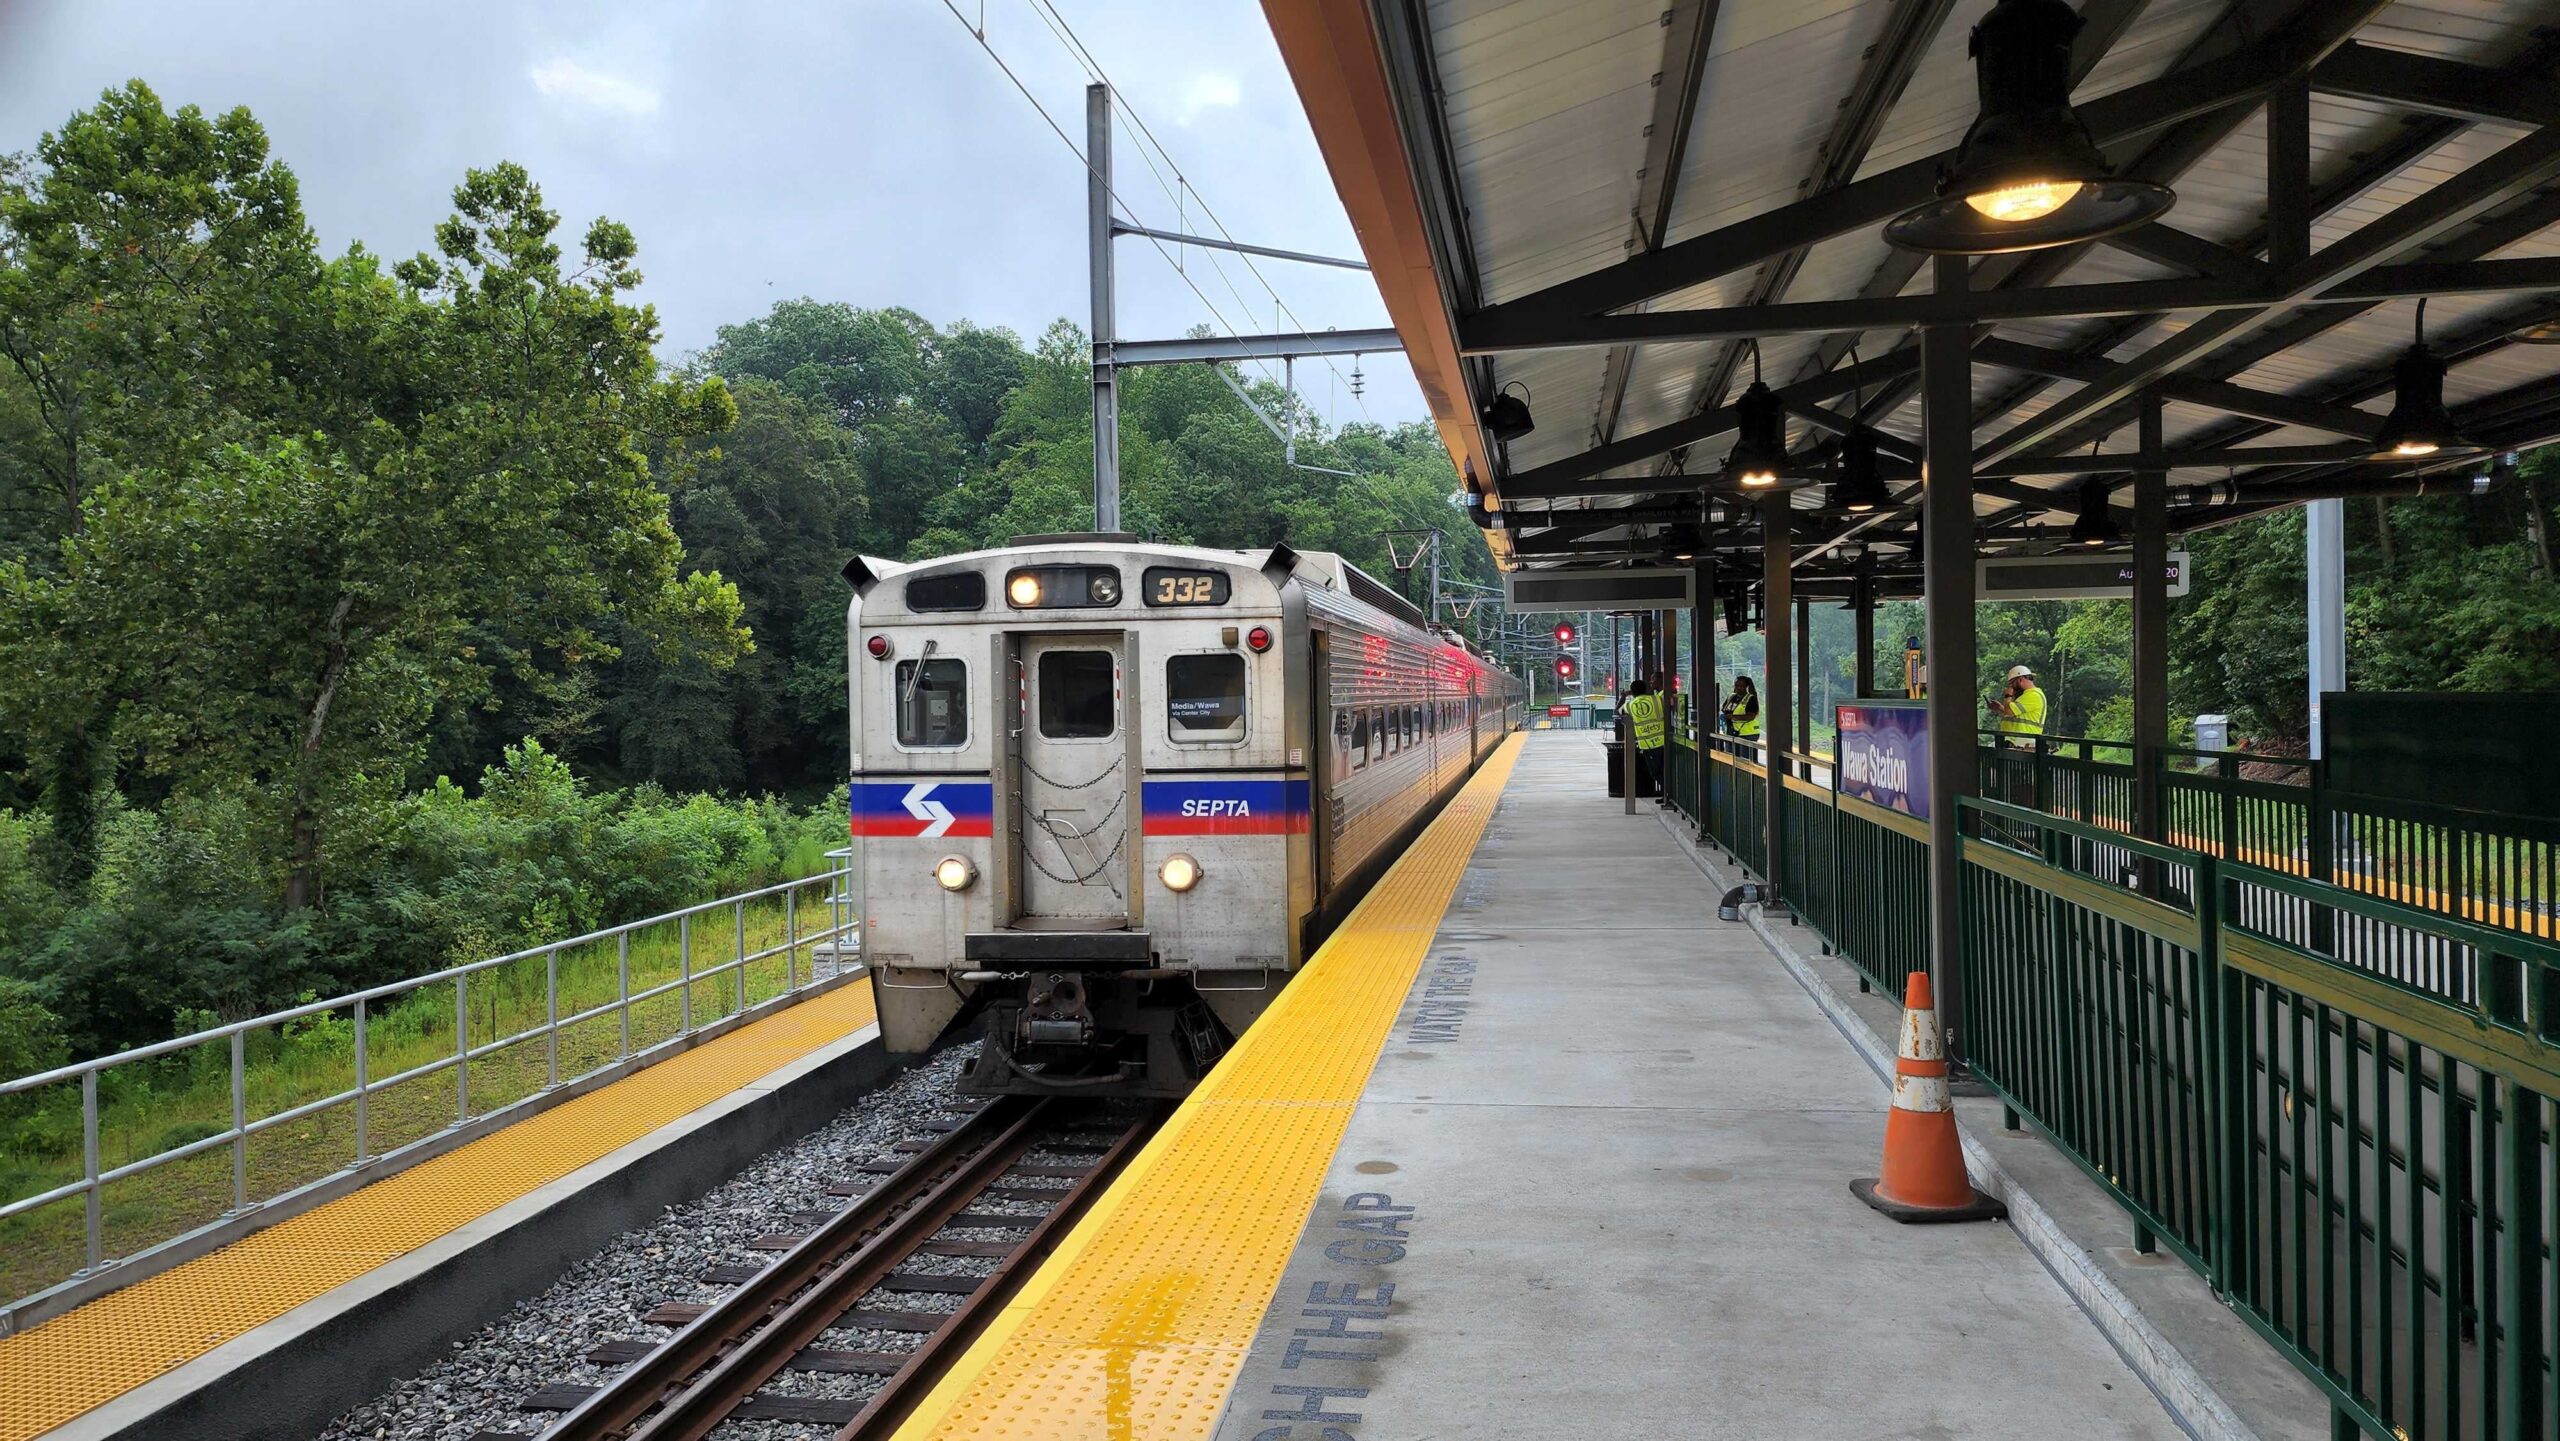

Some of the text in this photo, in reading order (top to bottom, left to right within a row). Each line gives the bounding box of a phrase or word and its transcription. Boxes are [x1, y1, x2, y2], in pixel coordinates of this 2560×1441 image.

[1157, 577, 1213, 602] 332
[2119, 569, 2133, 579] Au
[1841, 741, 1908, 794] Wawa Station
[1181, 799, 1250, 817] SEPTA
[1406, 956, 1479, 1044] WATCH THE GAP
[1324, 1192, 1416, 1266] GAP
[1280, 1281, 1396, 1370] THE
